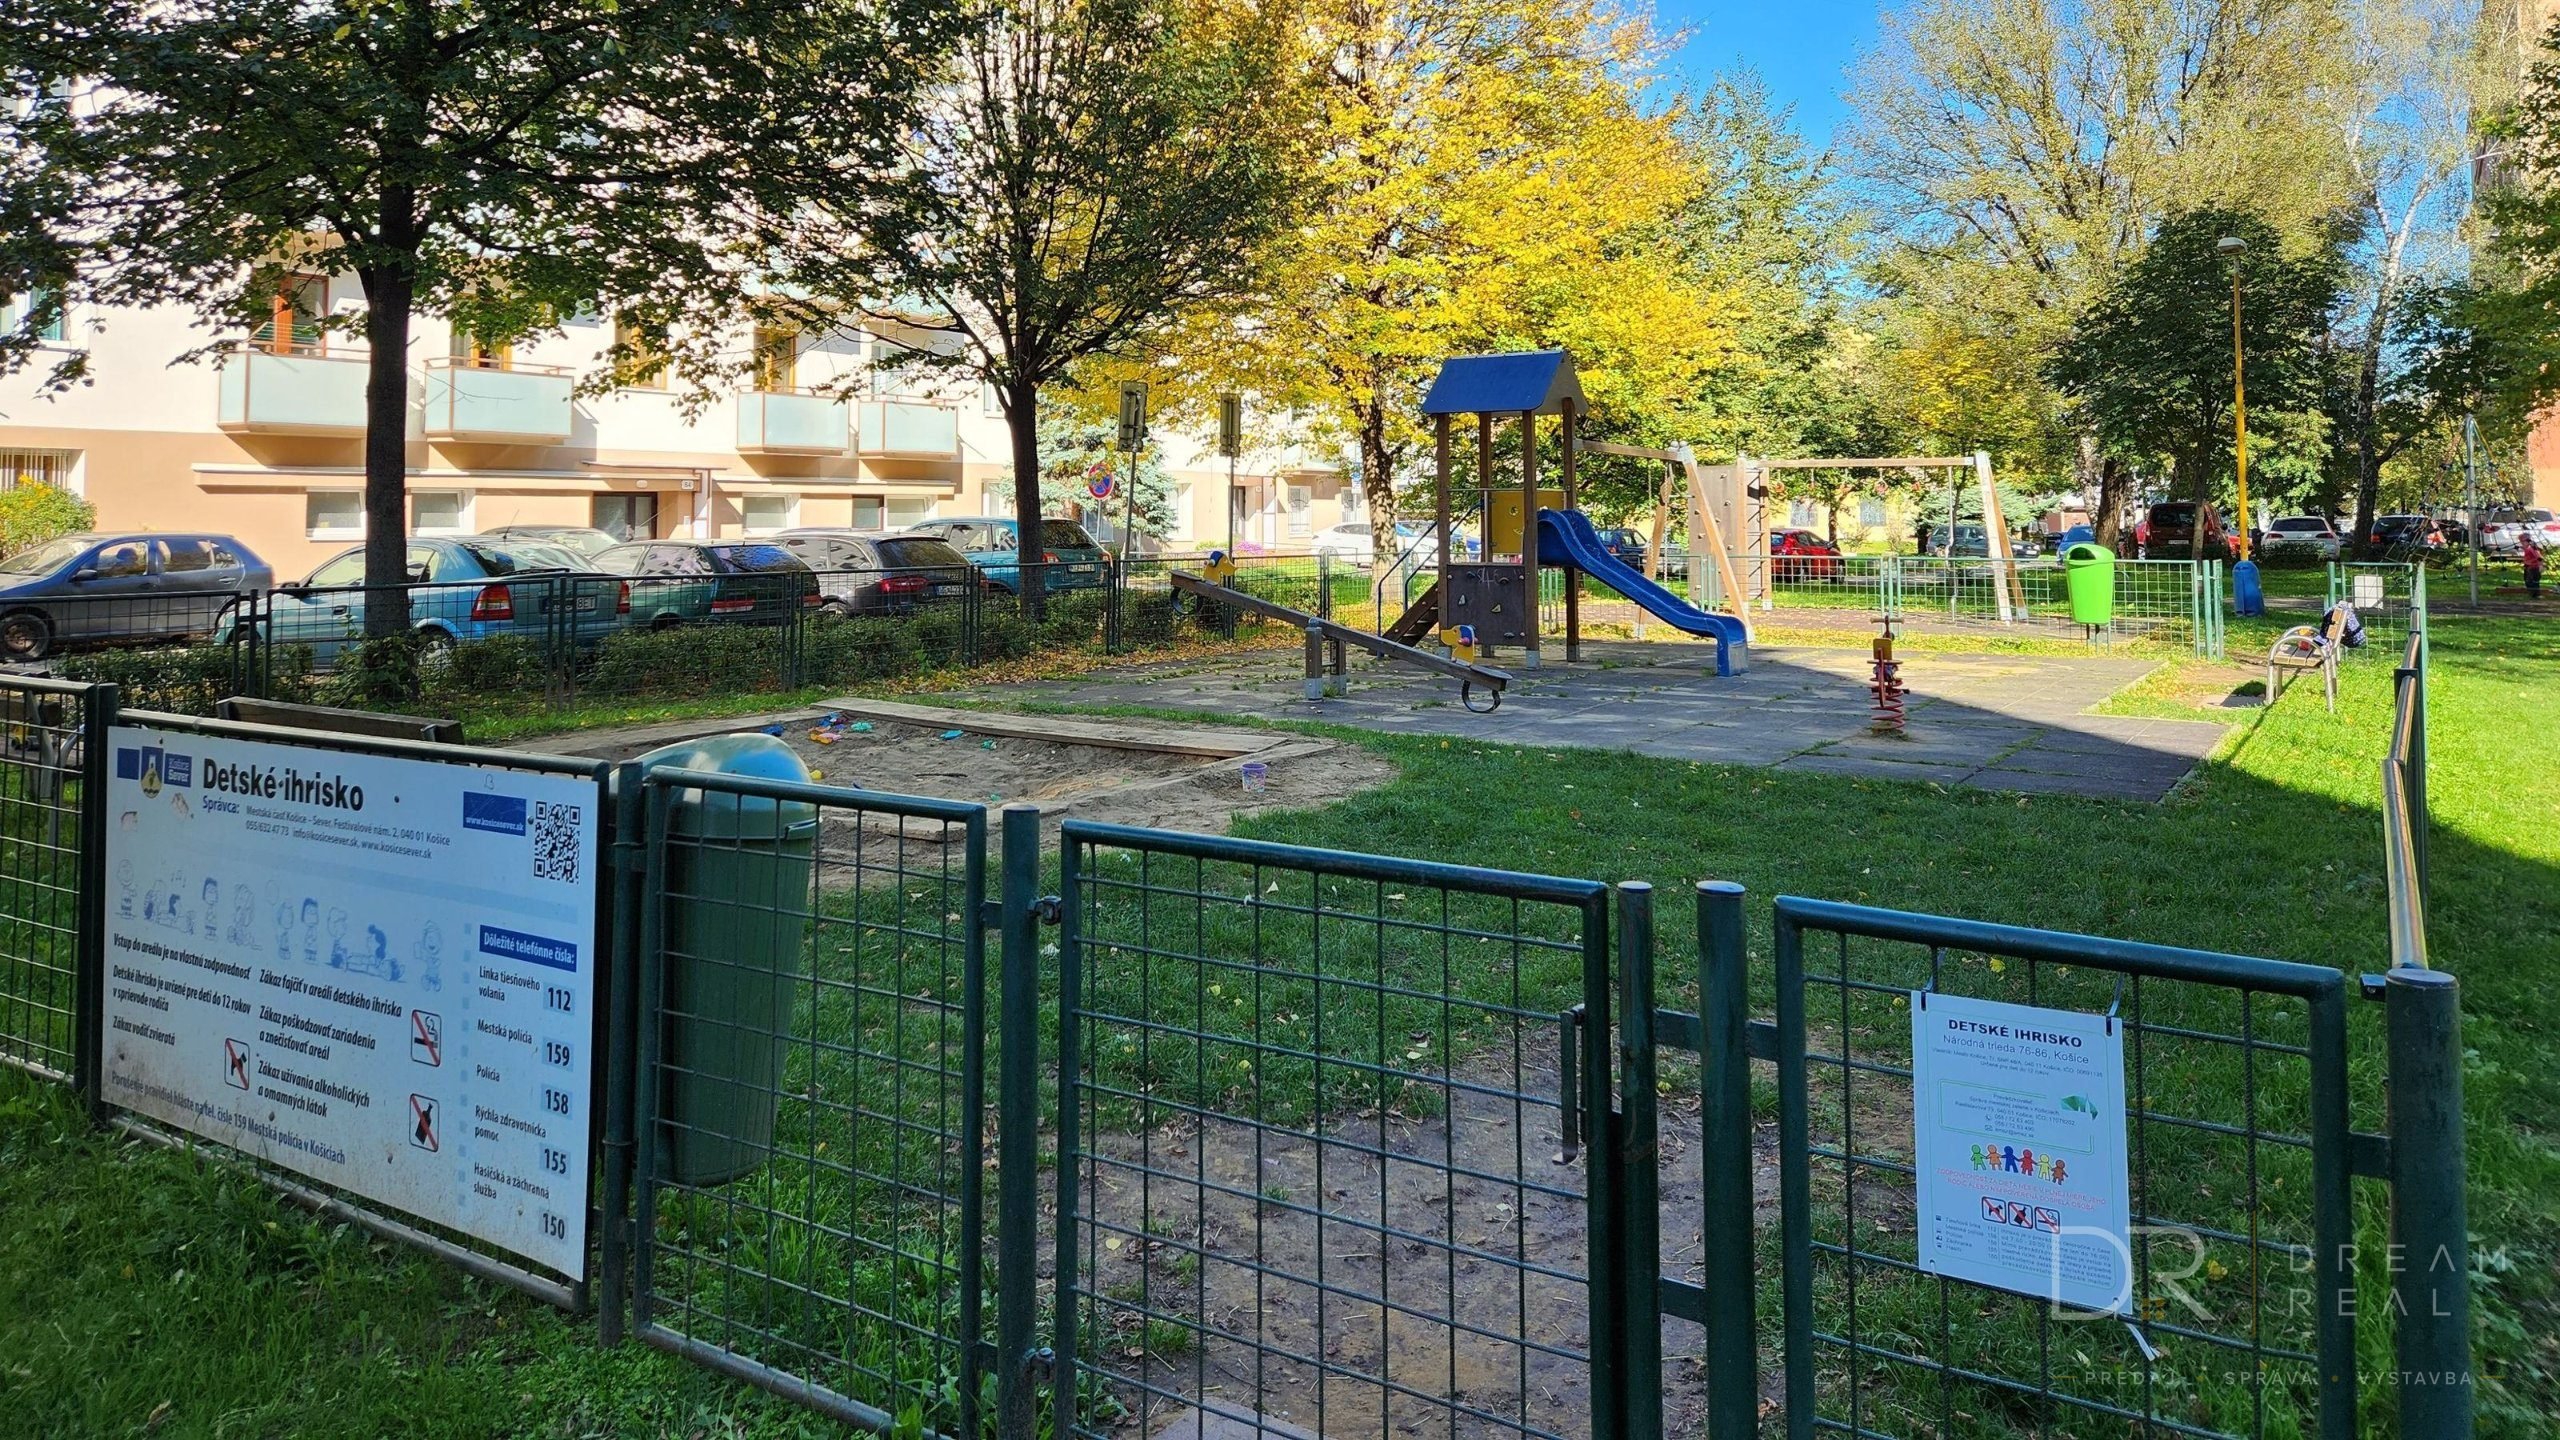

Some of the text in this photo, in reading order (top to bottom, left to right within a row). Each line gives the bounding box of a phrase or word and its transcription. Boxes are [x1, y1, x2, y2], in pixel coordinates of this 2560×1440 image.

[168, 770, 189, 782] Sever
[204, 758, 364, 811] Detské ihrisko
[202, 795, 240, 814] Správca:
[334, 818, 372, 834] Festivalové
[374, 825, 390, 837] nám.
[400, 829, 414, 841] 040
[416, 832, 424, 842] 01
[426, 832, 450, 847] Košice
[114, 932, 252, 980] Vstup do areálu je na vlastnú zodpovednosť
[484, 932, 574, 964] Dôležité telefónne čísla:
[113, 964, 252, 1014] Detské ihrisko je určené pre deti do 12 rokov
[480, 966, 540, 991] Linka tiesňového
[112, 988, 169, 1012] v sprievode rodiča
[260, 969, 402, 1018] Zákaz fajčiť v areáli detského ihriska
[480, 986, 505, 1002] volania
[548, 988, 571, 1012] 112
[112, 1015, 176, 1046] Zákaz vodiť zvieratá
[260, 1005, 376, 1050] Zákaz poškodzovať zariadenia
[478, 1019, 532, 1044] Mestská polícia
[1948, 1019, 2082, 1048] DETSKÉ IHRISKO
[259, 1030, 330, 1060] a znečisťovať areál
[547, 1042, 570, 1067] 159
[1944, 1034, 2089, 1065] Národná trieda 76-86, Košice
[258, 1060, 370, 1108] Zákaz užívania alkoholických
[476, 1064, 500, 1082] Polícia
[258, 1085, 328, 1118] a omamných látok
[476, 1105, 498, 1123] Rýchla
[546, 1089, 568, 1115] 158
[234, 1113, 247, 1129] 159
[248, 1118, 278, 1142] Mestská
[278, 1130, 303, 1151] polícia
[304, 1141, 309, 1152] v
[310, 1138, 346, 1166] Košiciach
[475, 1126, 500, 1142] pomoc
[544, 1148, 566, 1175] 155
[474, 1162, 550, 1200] Hasičská a záchranná
[474, 1182, 497, 1200] služba
[543, 1213, 564, 1240] 150
